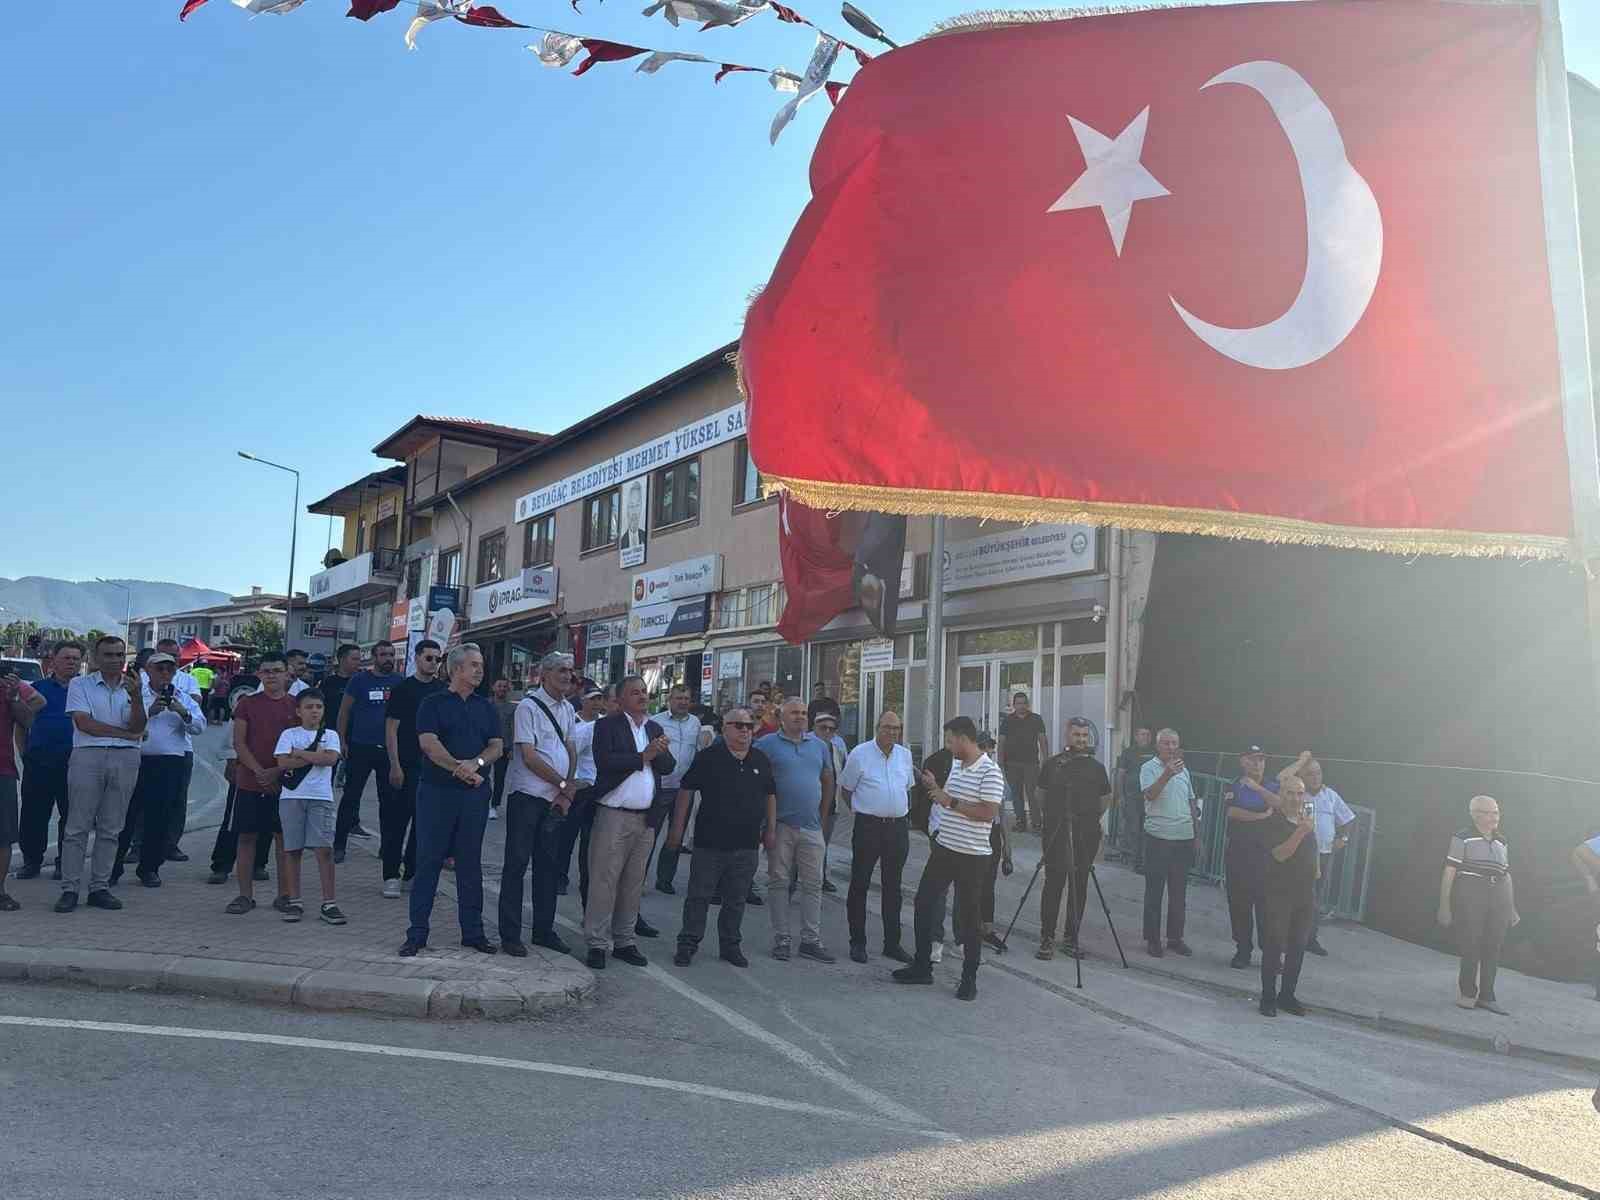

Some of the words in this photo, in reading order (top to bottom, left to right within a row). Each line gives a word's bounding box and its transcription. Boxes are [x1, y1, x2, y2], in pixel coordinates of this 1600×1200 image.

[531, 484, 567, 512] BEYAĞAÇ
[571, 457, 623, 496] BELEDİYESİ
[627, 440, 670, 473] MEHMET
[675, 421, 720, 454] YÜKSEL
[728, 411, 746, 432] SA
